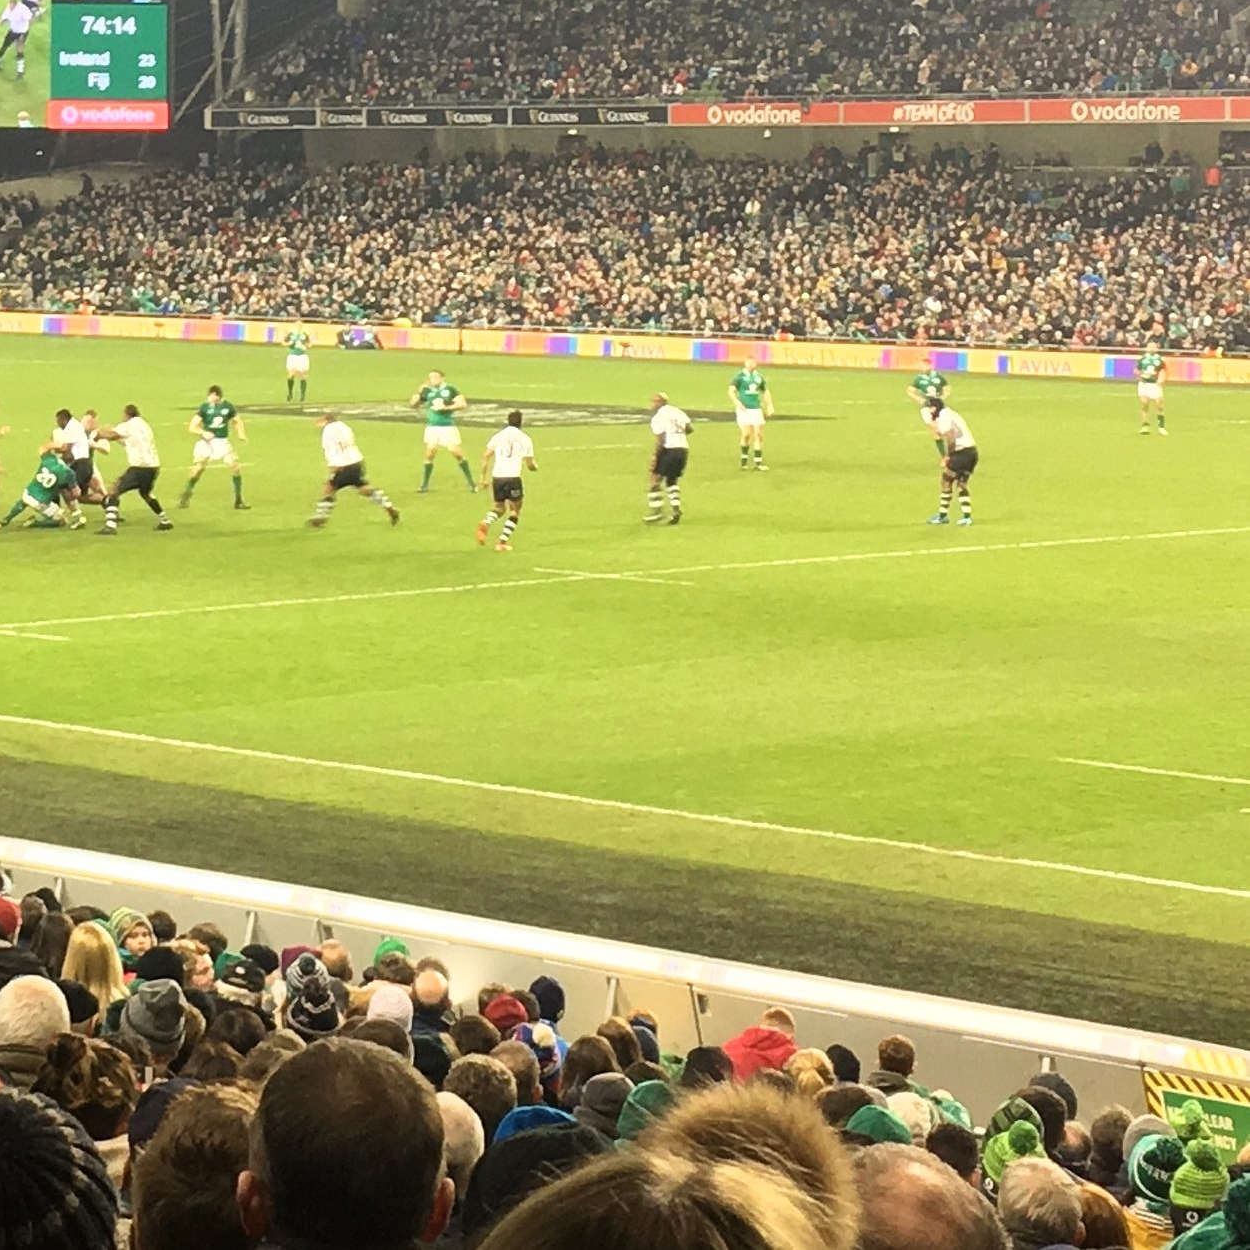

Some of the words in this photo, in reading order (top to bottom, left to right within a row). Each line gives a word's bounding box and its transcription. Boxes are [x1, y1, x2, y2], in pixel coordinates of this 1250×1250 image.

[81, 15, 137, 35] 74:14
[59, 51, 110, 66] Ireland
[81, 106, 155, 123] vodafone
[724, 105, 801, 125] vodafone
[1090, 100, 1181, 121] vodafone
[1019, 359, 1072, 375] AVIVA
